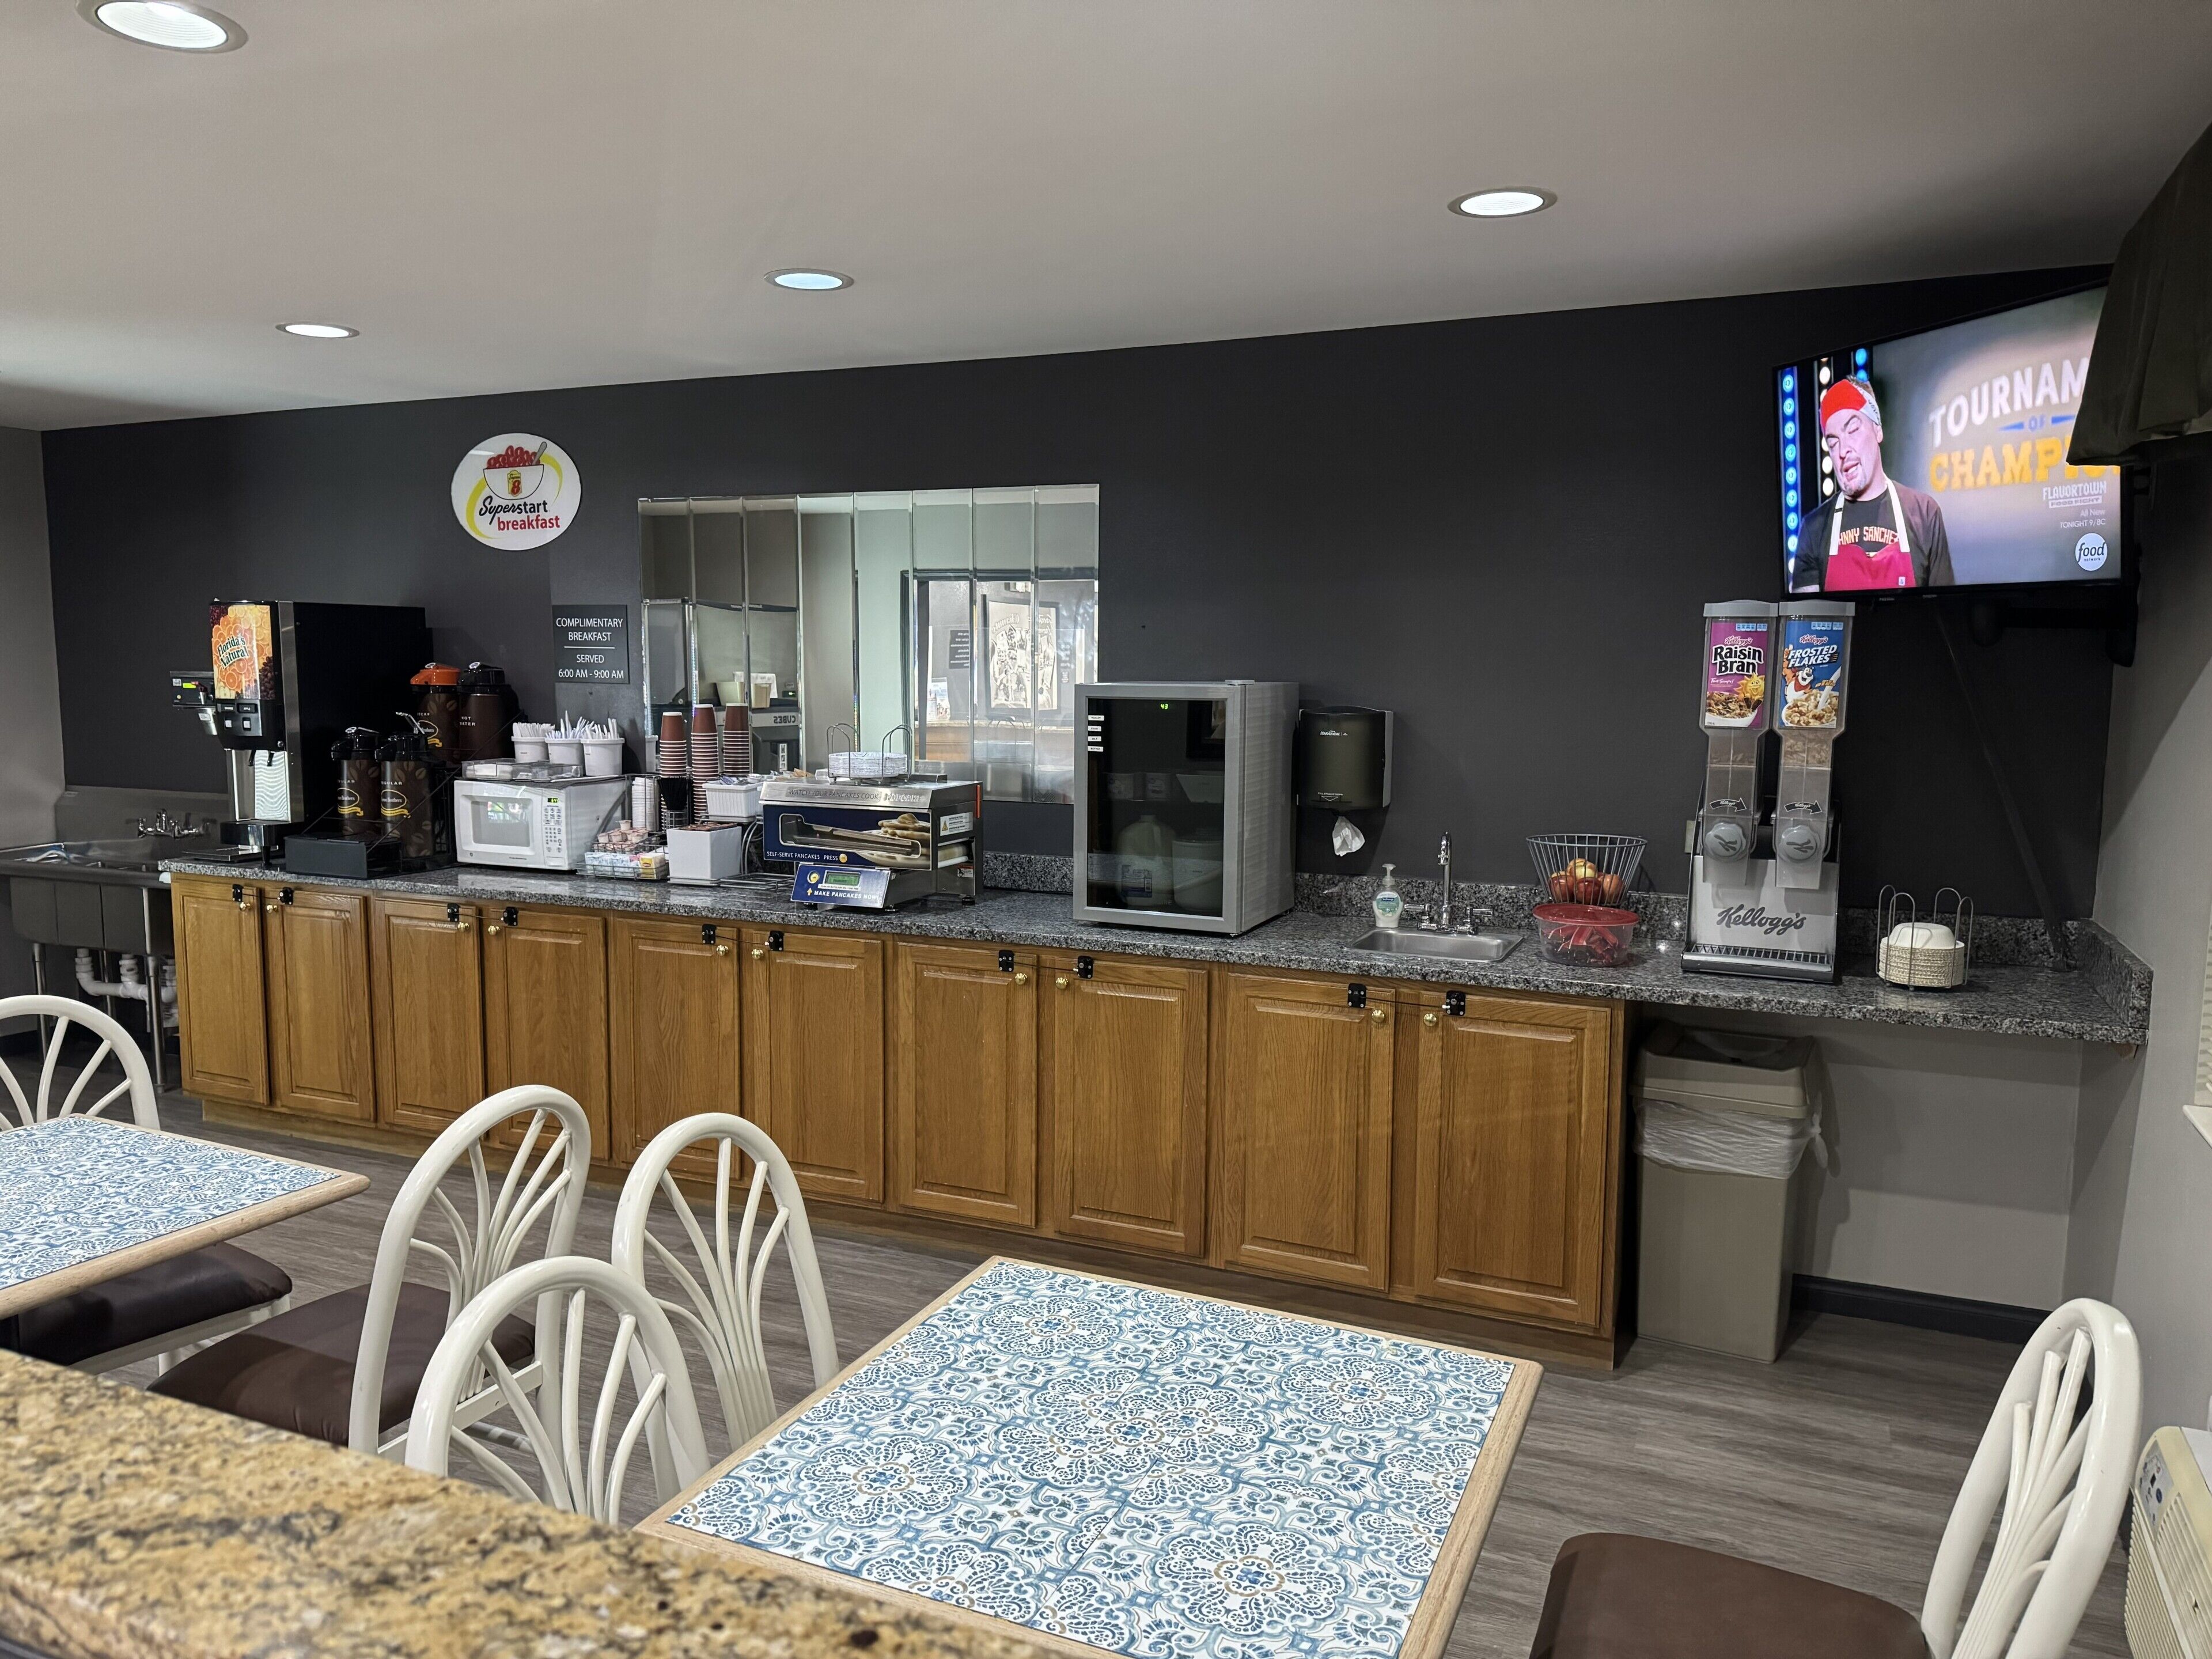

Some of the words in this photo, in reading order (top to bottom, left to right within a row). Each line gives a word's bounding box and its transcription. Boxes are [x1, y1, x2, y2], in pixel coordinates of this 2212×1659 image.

[2028, 414, 2046, 432] OF
[479, 495, 548, 525] Superstart
[497, 514, 560, 531] breakfast
[2060, 520, 2088, 528] TONIGHT
[2089, 518, 2105, 527] 9/8C
[2078, 542, 2106, 563] food
[556, 618, 623, 627] COMPLIMENTARY
[568, 631, 612, 641] BREAKFAST
[1725, 635, 1753, 646] Kellogg's
[1799, 634, 1828, 645] Kellogg's
[217, 634, 246, 657] Florida's
[1788, 645, 1838, 660] FROSTED
[221, 646, 249, 667] Natural
[577, 654, 604, 663] SERVED
[1713, 646, 1763, 663] Raisin
[1788, 654, 1831, 668] FLAKES
[558, 669, 574, 677] 6:00
[575, 669, 588, 678] AM
[594, 669, 609, 679] 9:00
[611, 670, 624, 679] AM
[1718, 660, 1756, 674] Bran
[1716, 903, 1806, 936] Kellogg's
